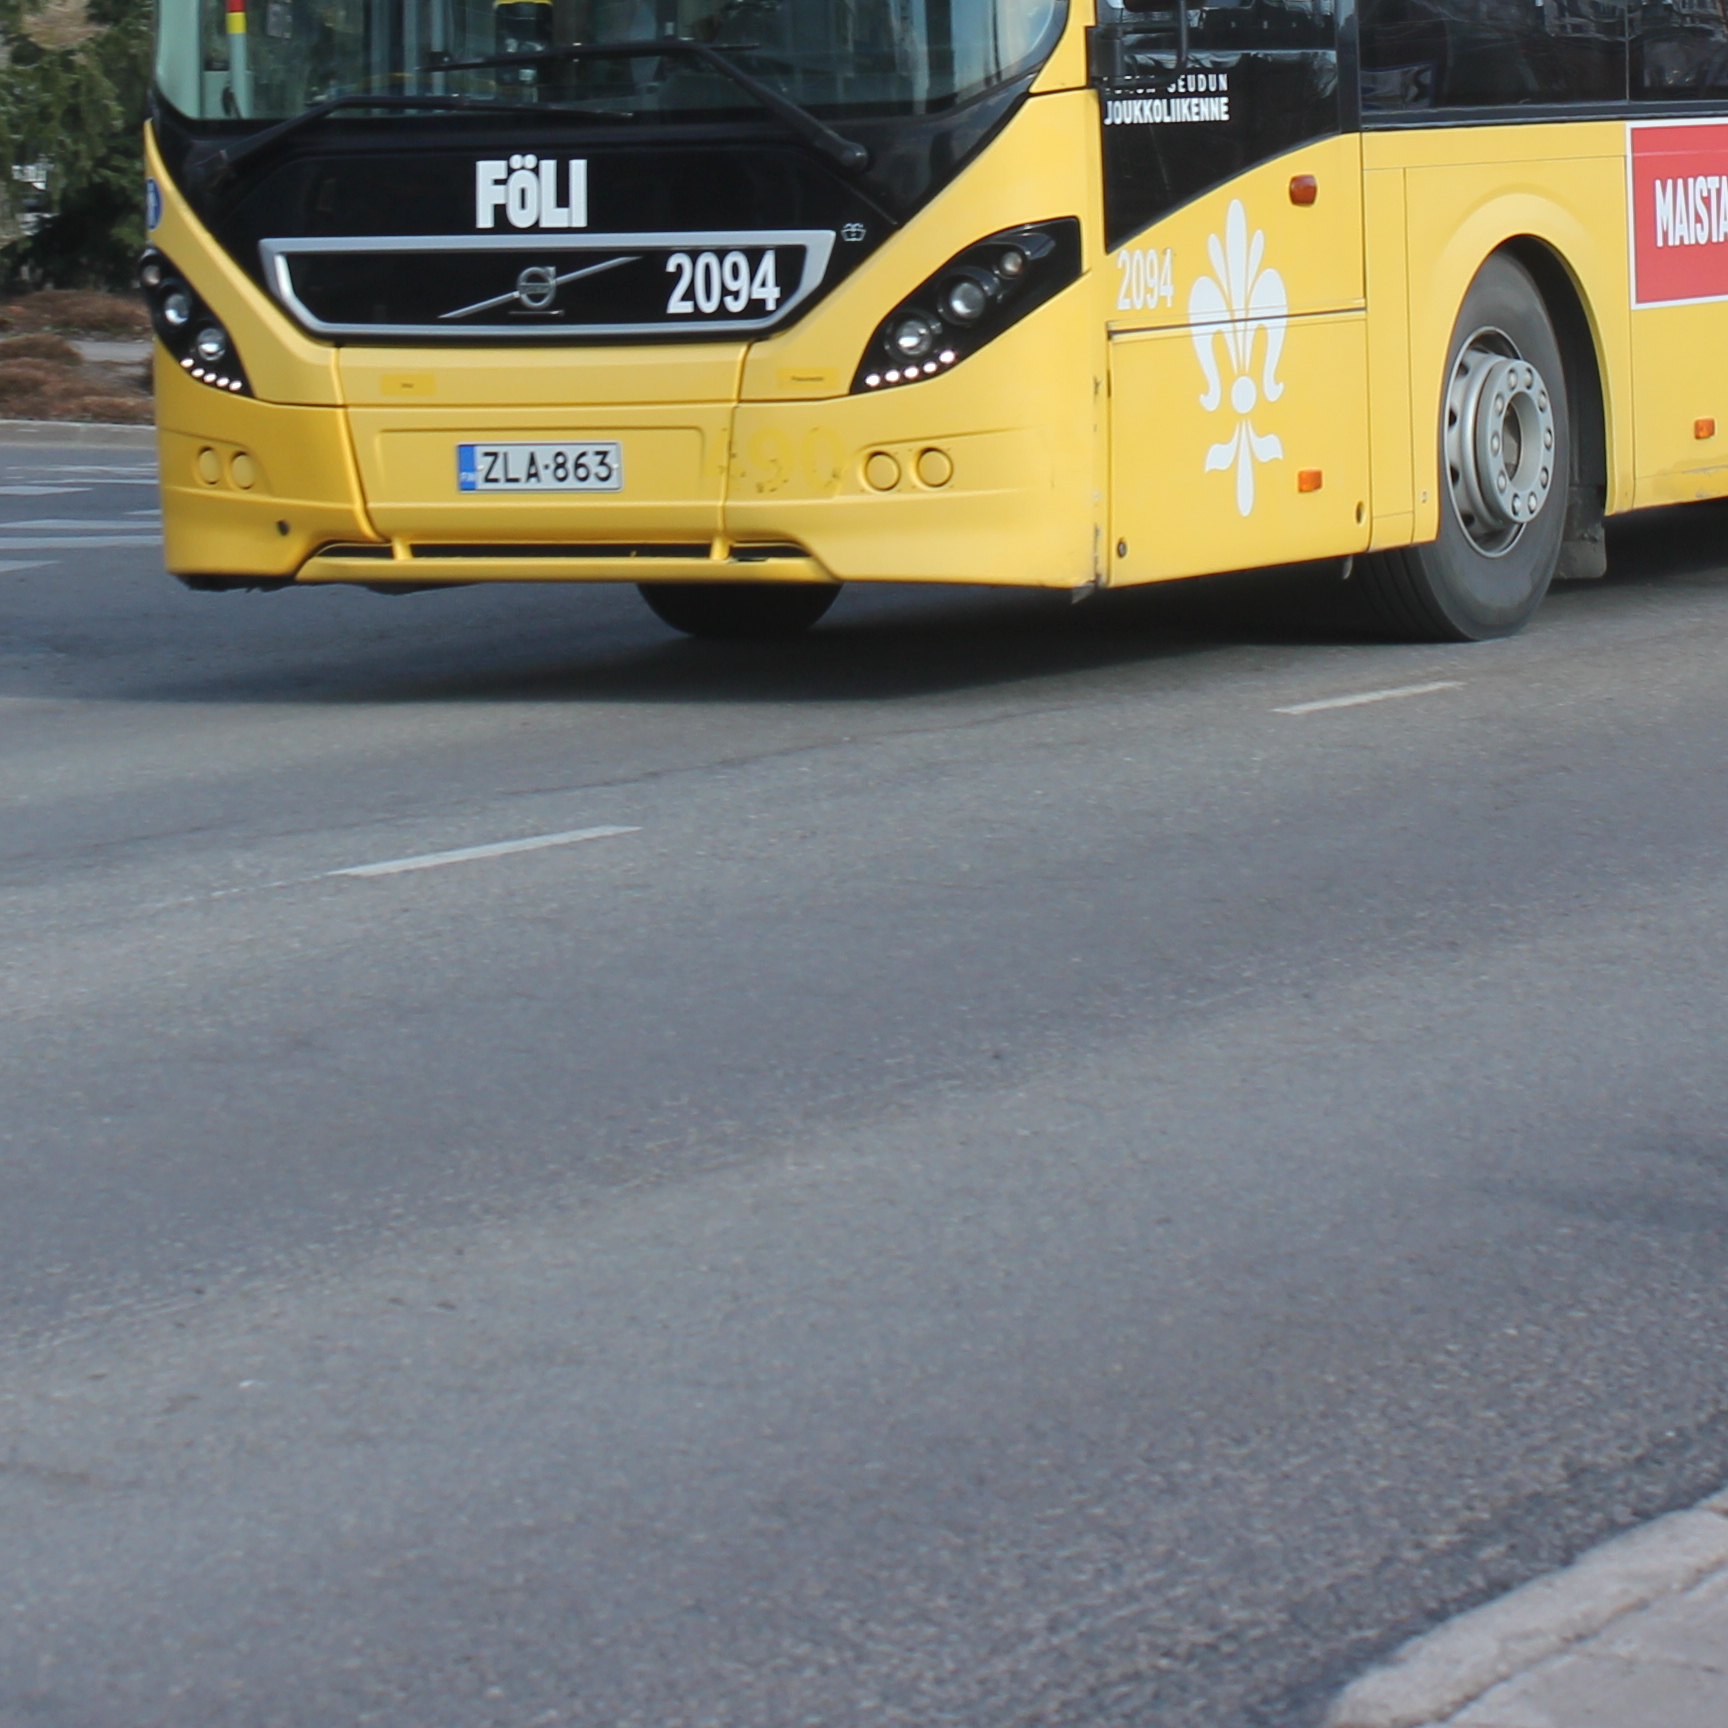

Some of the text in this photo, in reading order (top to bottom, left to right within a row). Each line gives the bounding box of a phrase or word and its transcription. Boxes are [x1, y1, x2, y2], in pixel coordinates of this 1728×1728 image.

[1104, 97, 1230, 125] JOUKKOLIIKENNE
[476, 154, 588, 229] FÖLI
[666, 250, 780, 313] 2094
[1117, 248, 1175, 310] 2094
[482, 451, 613, 483] ZLA-863
